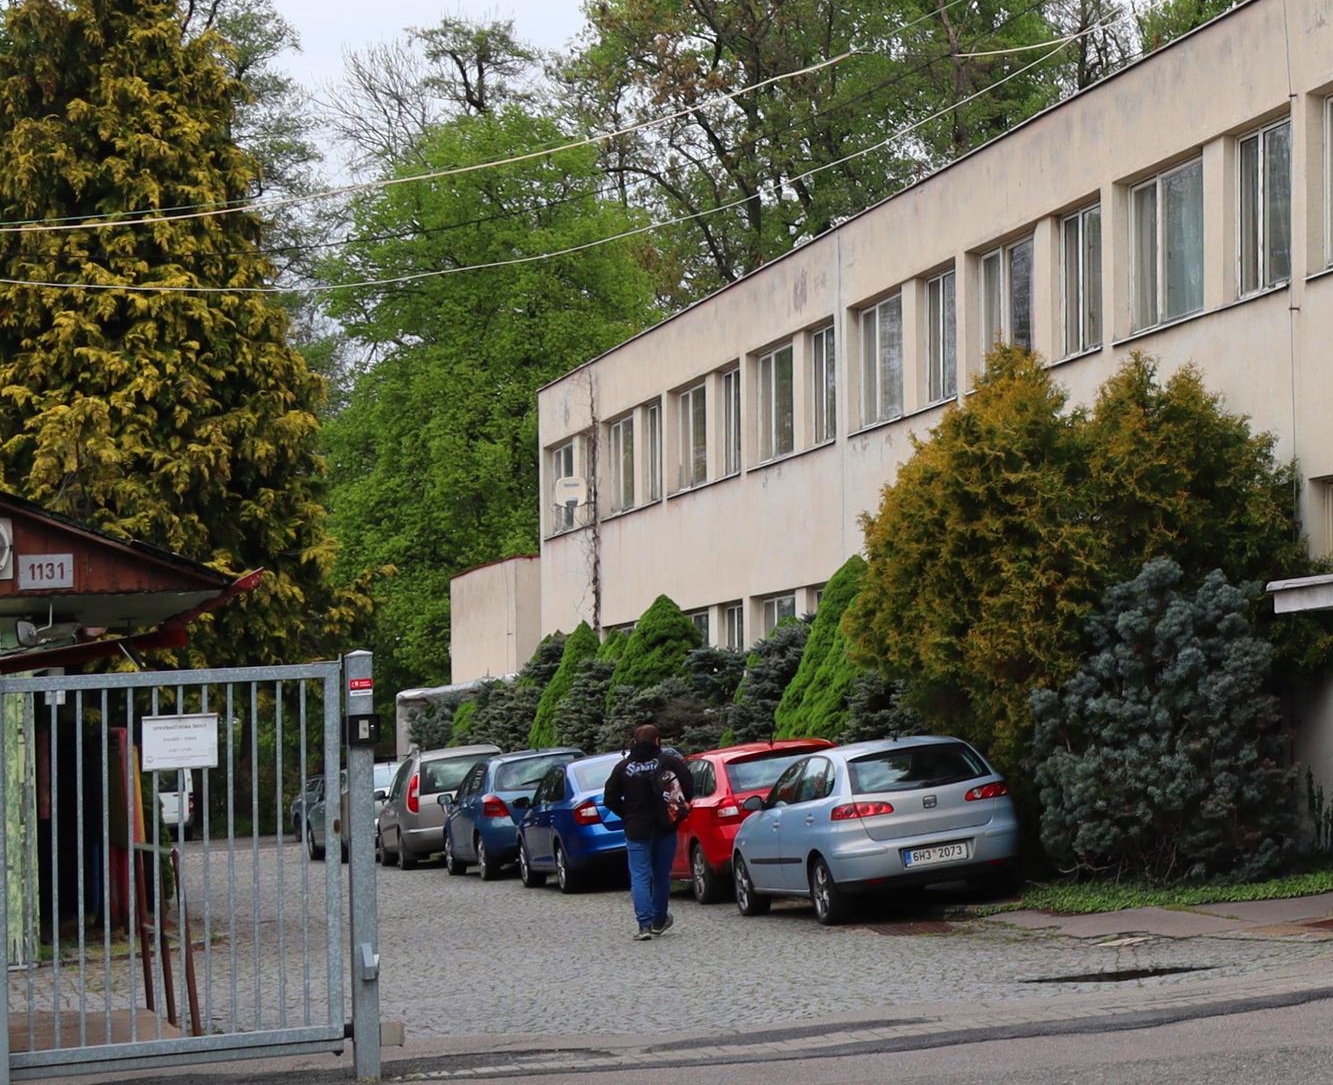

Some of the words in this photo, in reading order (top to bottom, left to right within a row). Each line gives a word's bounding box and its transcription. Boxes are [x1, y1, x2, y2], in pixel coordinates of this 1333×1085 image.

[28, 561, 65, 581] 1131
[913, 850, 931, 862] 6H3
[938, 845, 962, 858] 2073
